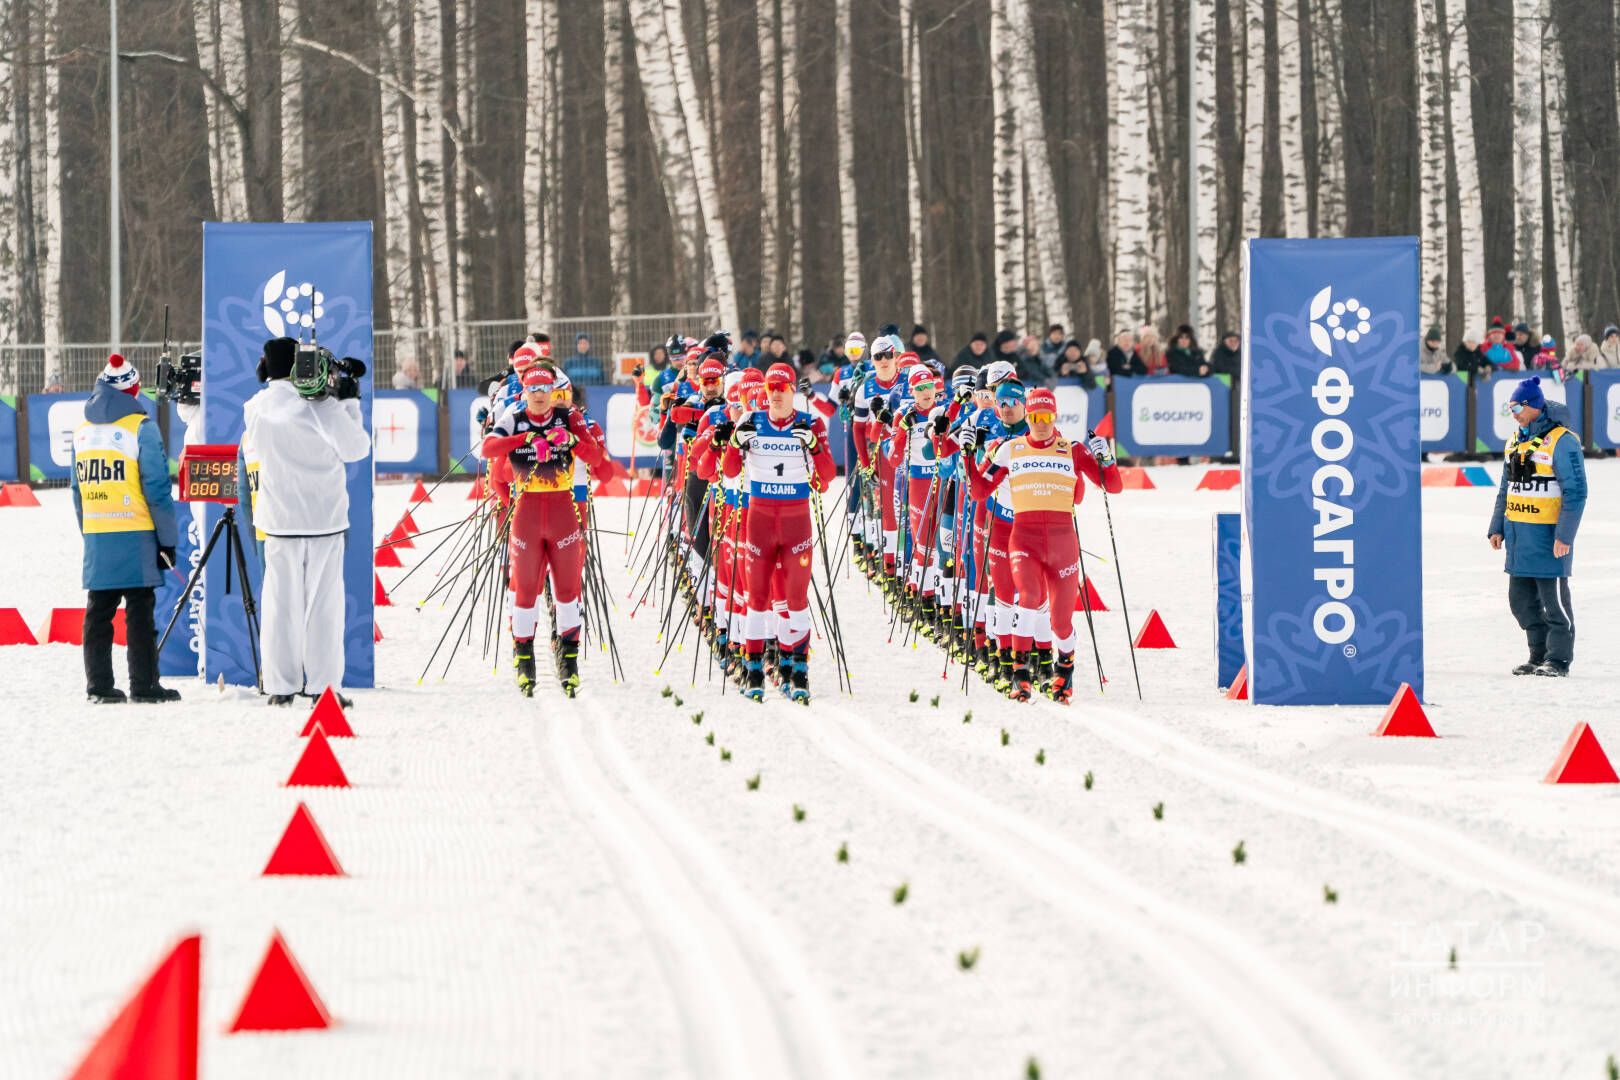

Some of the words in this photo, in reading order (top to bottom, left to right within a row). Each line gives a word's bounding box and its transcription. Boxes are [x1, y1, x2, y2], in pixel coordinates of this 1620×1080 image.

[766, 369, 790, 380] LUKOIL
[1028, 396, 1055, 406] LUKOIL
[762, 443, 802, 452] ФОСАГР
[773, 463, 784, 477] 1
[1022, 461, 1071, 472] ФОСАГРО
[760, 483, 797, 495] КАЗАНЬ
[86, 491, 109, 501] ЗАНЬ
[1311, 366, 1356, 645] ФОСАГРО
[1507, 501, 1540, 514] ЗАНЬ
